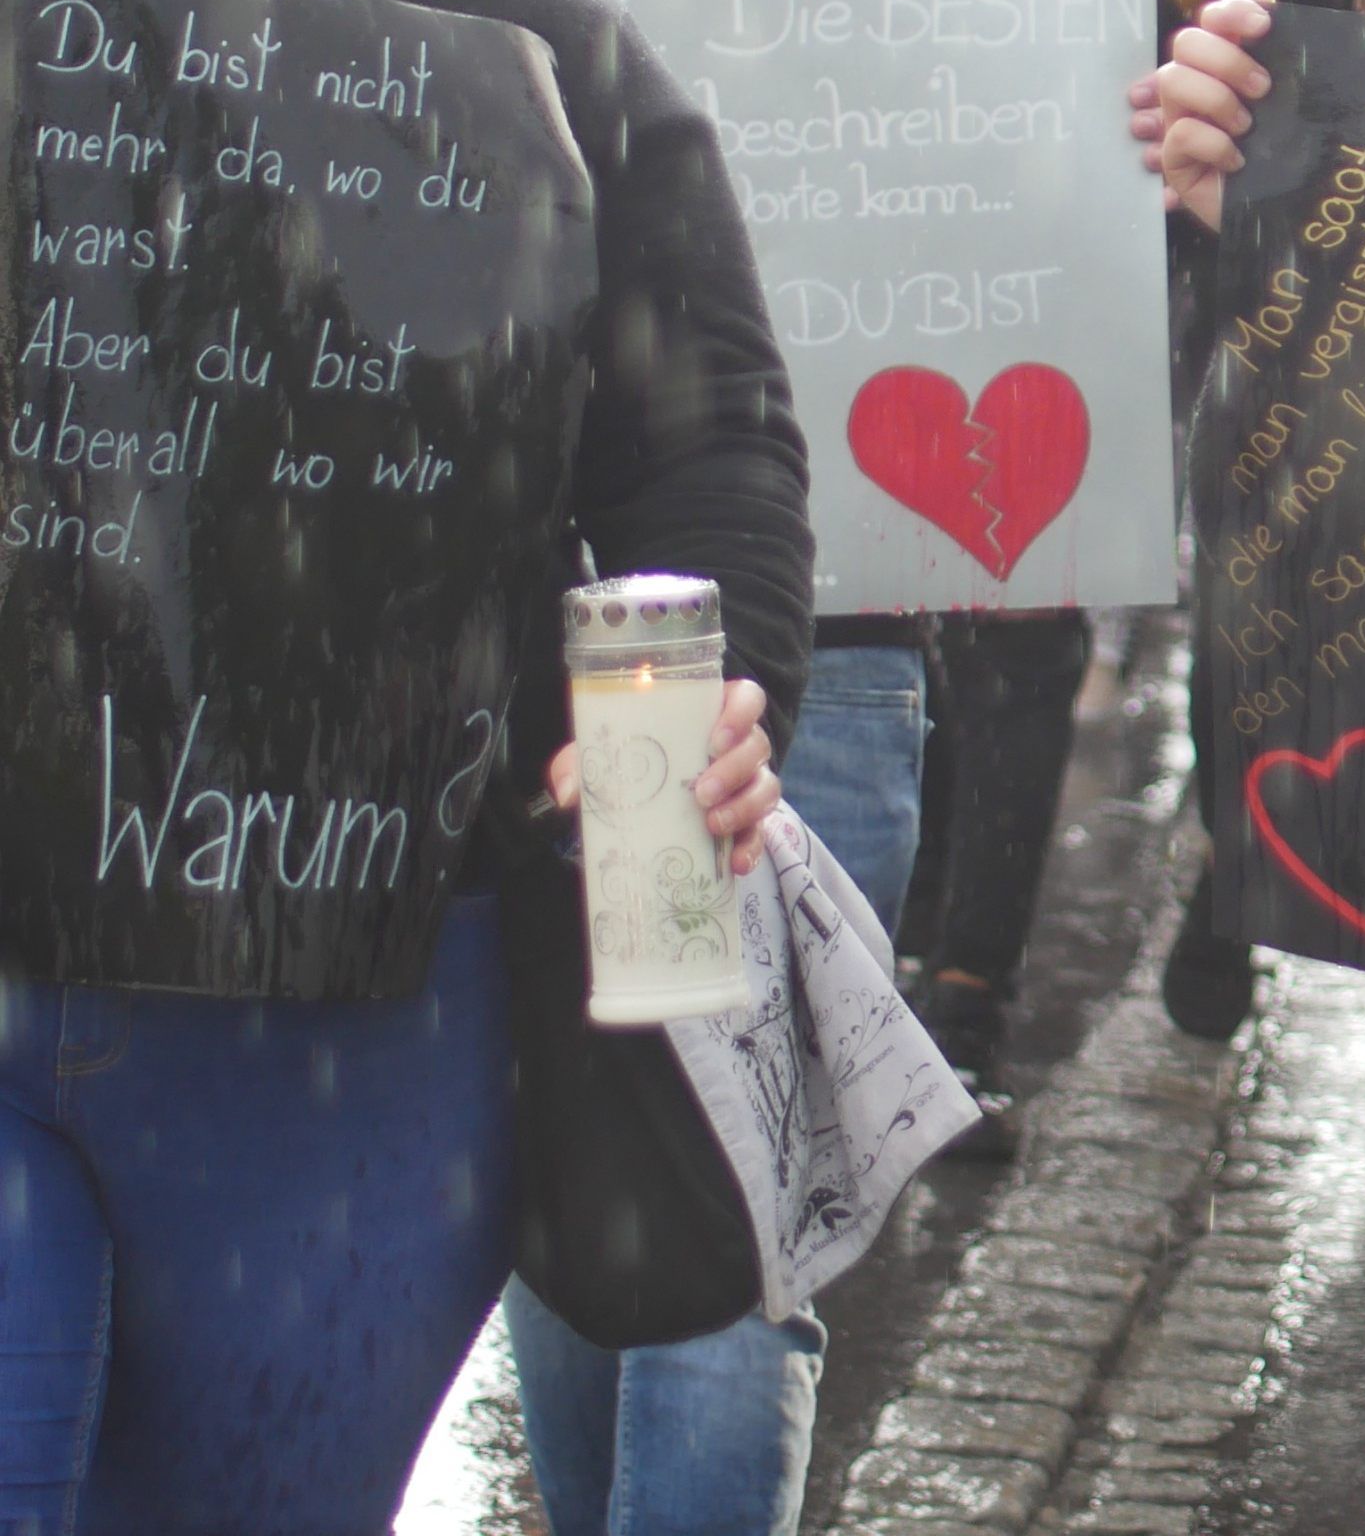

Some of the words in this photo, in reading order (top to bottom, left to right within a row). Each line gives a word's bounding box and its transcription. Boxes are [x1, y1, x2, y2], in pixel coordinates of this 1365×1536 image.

[176, 11, 282, 92] bist
[315, 36, 432, 117] nicht
[35, 101, 167, 173] mehr
[325, 160, 382, 200] wo
[418, 142, 488, 213] du
[691, 65, 1072, 160] beschreiben
[31, 192, 193, 270] warst.
[18, 296, 151, 372] Aber
[195, 306, 273, 388] du
[310, 318, 417, 393] bist
[789, 275, 895, 345] DU
[906, 267, 1064, 336] BIST
[1222, 266, 1310, 373] Man
[8, 382, 220, 477] überall
[271, 450, 336, 490] wo
[372, 444, 454, 494] wir
[1231, 402, 1308, 495] man
[2, 490, 143, 564] sind.
[1227, 526, 1283, 588] die
[1278, 437, 1358, 526] man
[1219, 601, 1298, 669] Ich
[1232, 673, 1307, 736] den
